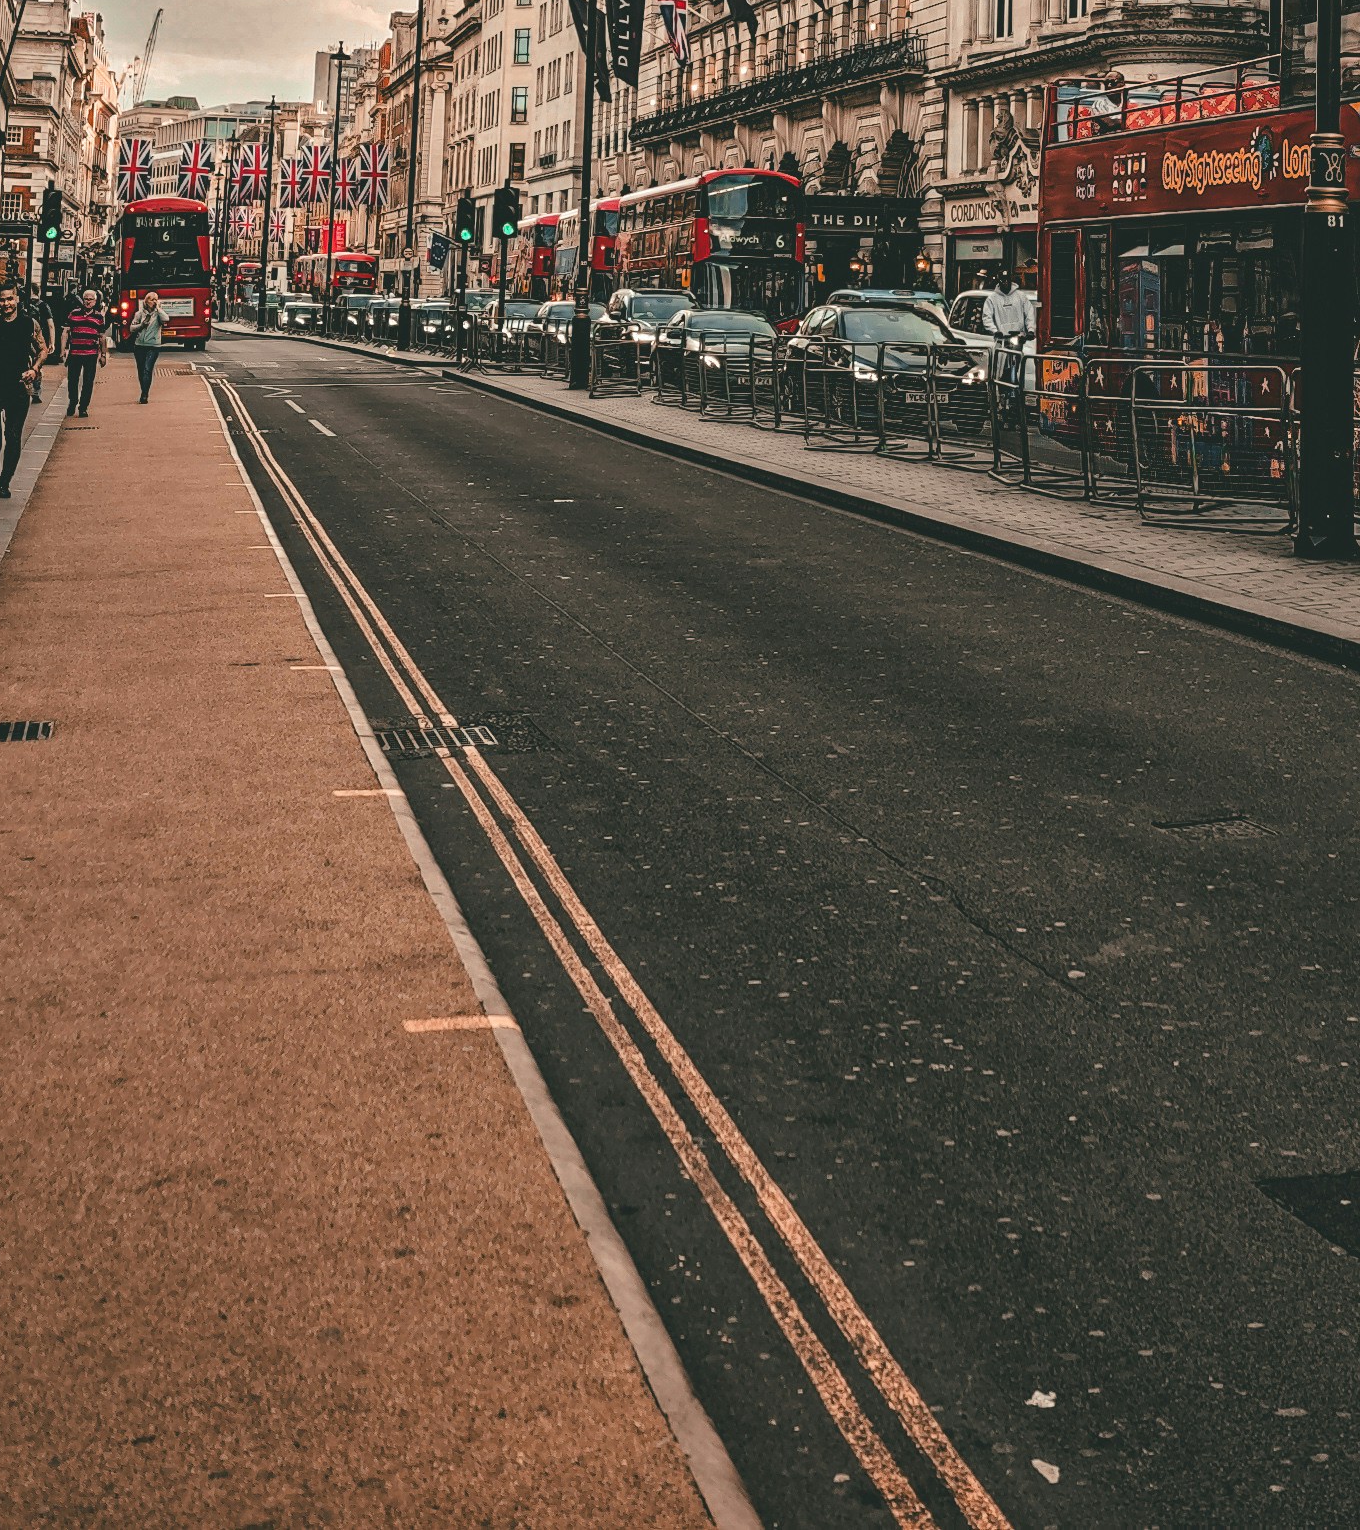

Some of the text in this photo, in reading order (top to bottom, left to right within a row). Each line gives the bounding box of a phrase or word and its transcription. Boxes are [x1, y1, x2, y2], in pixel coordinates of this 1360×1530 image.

[950, 201, 997, 222] CORDINGS
[811, 213, 845, 226] THE
[1327, 214, 1344, 228] 81
[162, 231, 170, 242] 6
[719, 234, 785, 248] Aldwych 6
